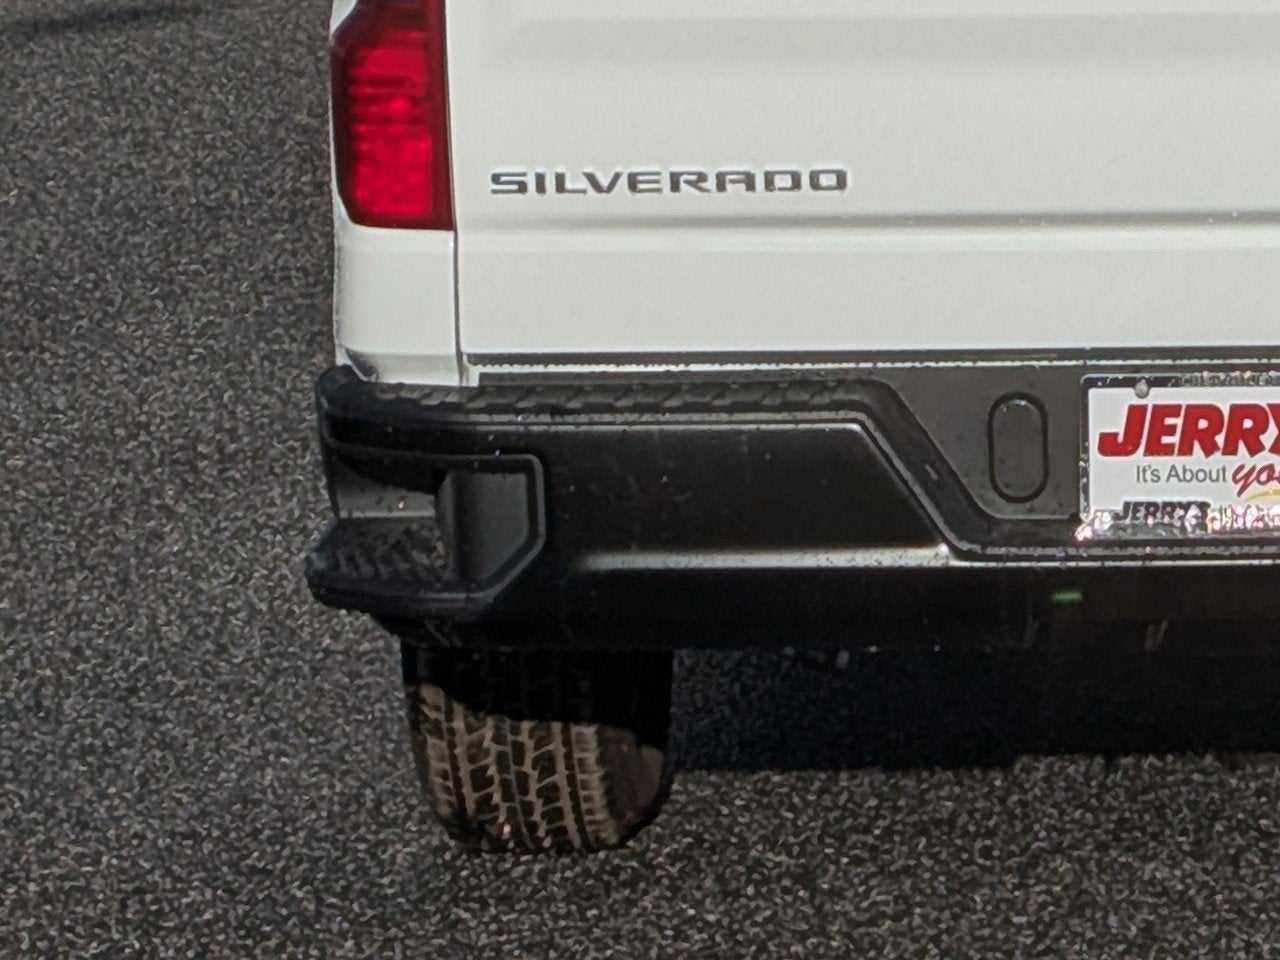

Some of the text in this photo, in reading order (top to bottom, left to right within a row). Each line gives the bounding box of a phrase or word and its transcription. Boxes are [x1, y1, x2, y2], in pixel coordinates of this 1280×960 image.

[490, 169, 848, 194] SILVERADO
[1135, 463, 1161, 484] It's
[1165, 463, 1227, 484] About
